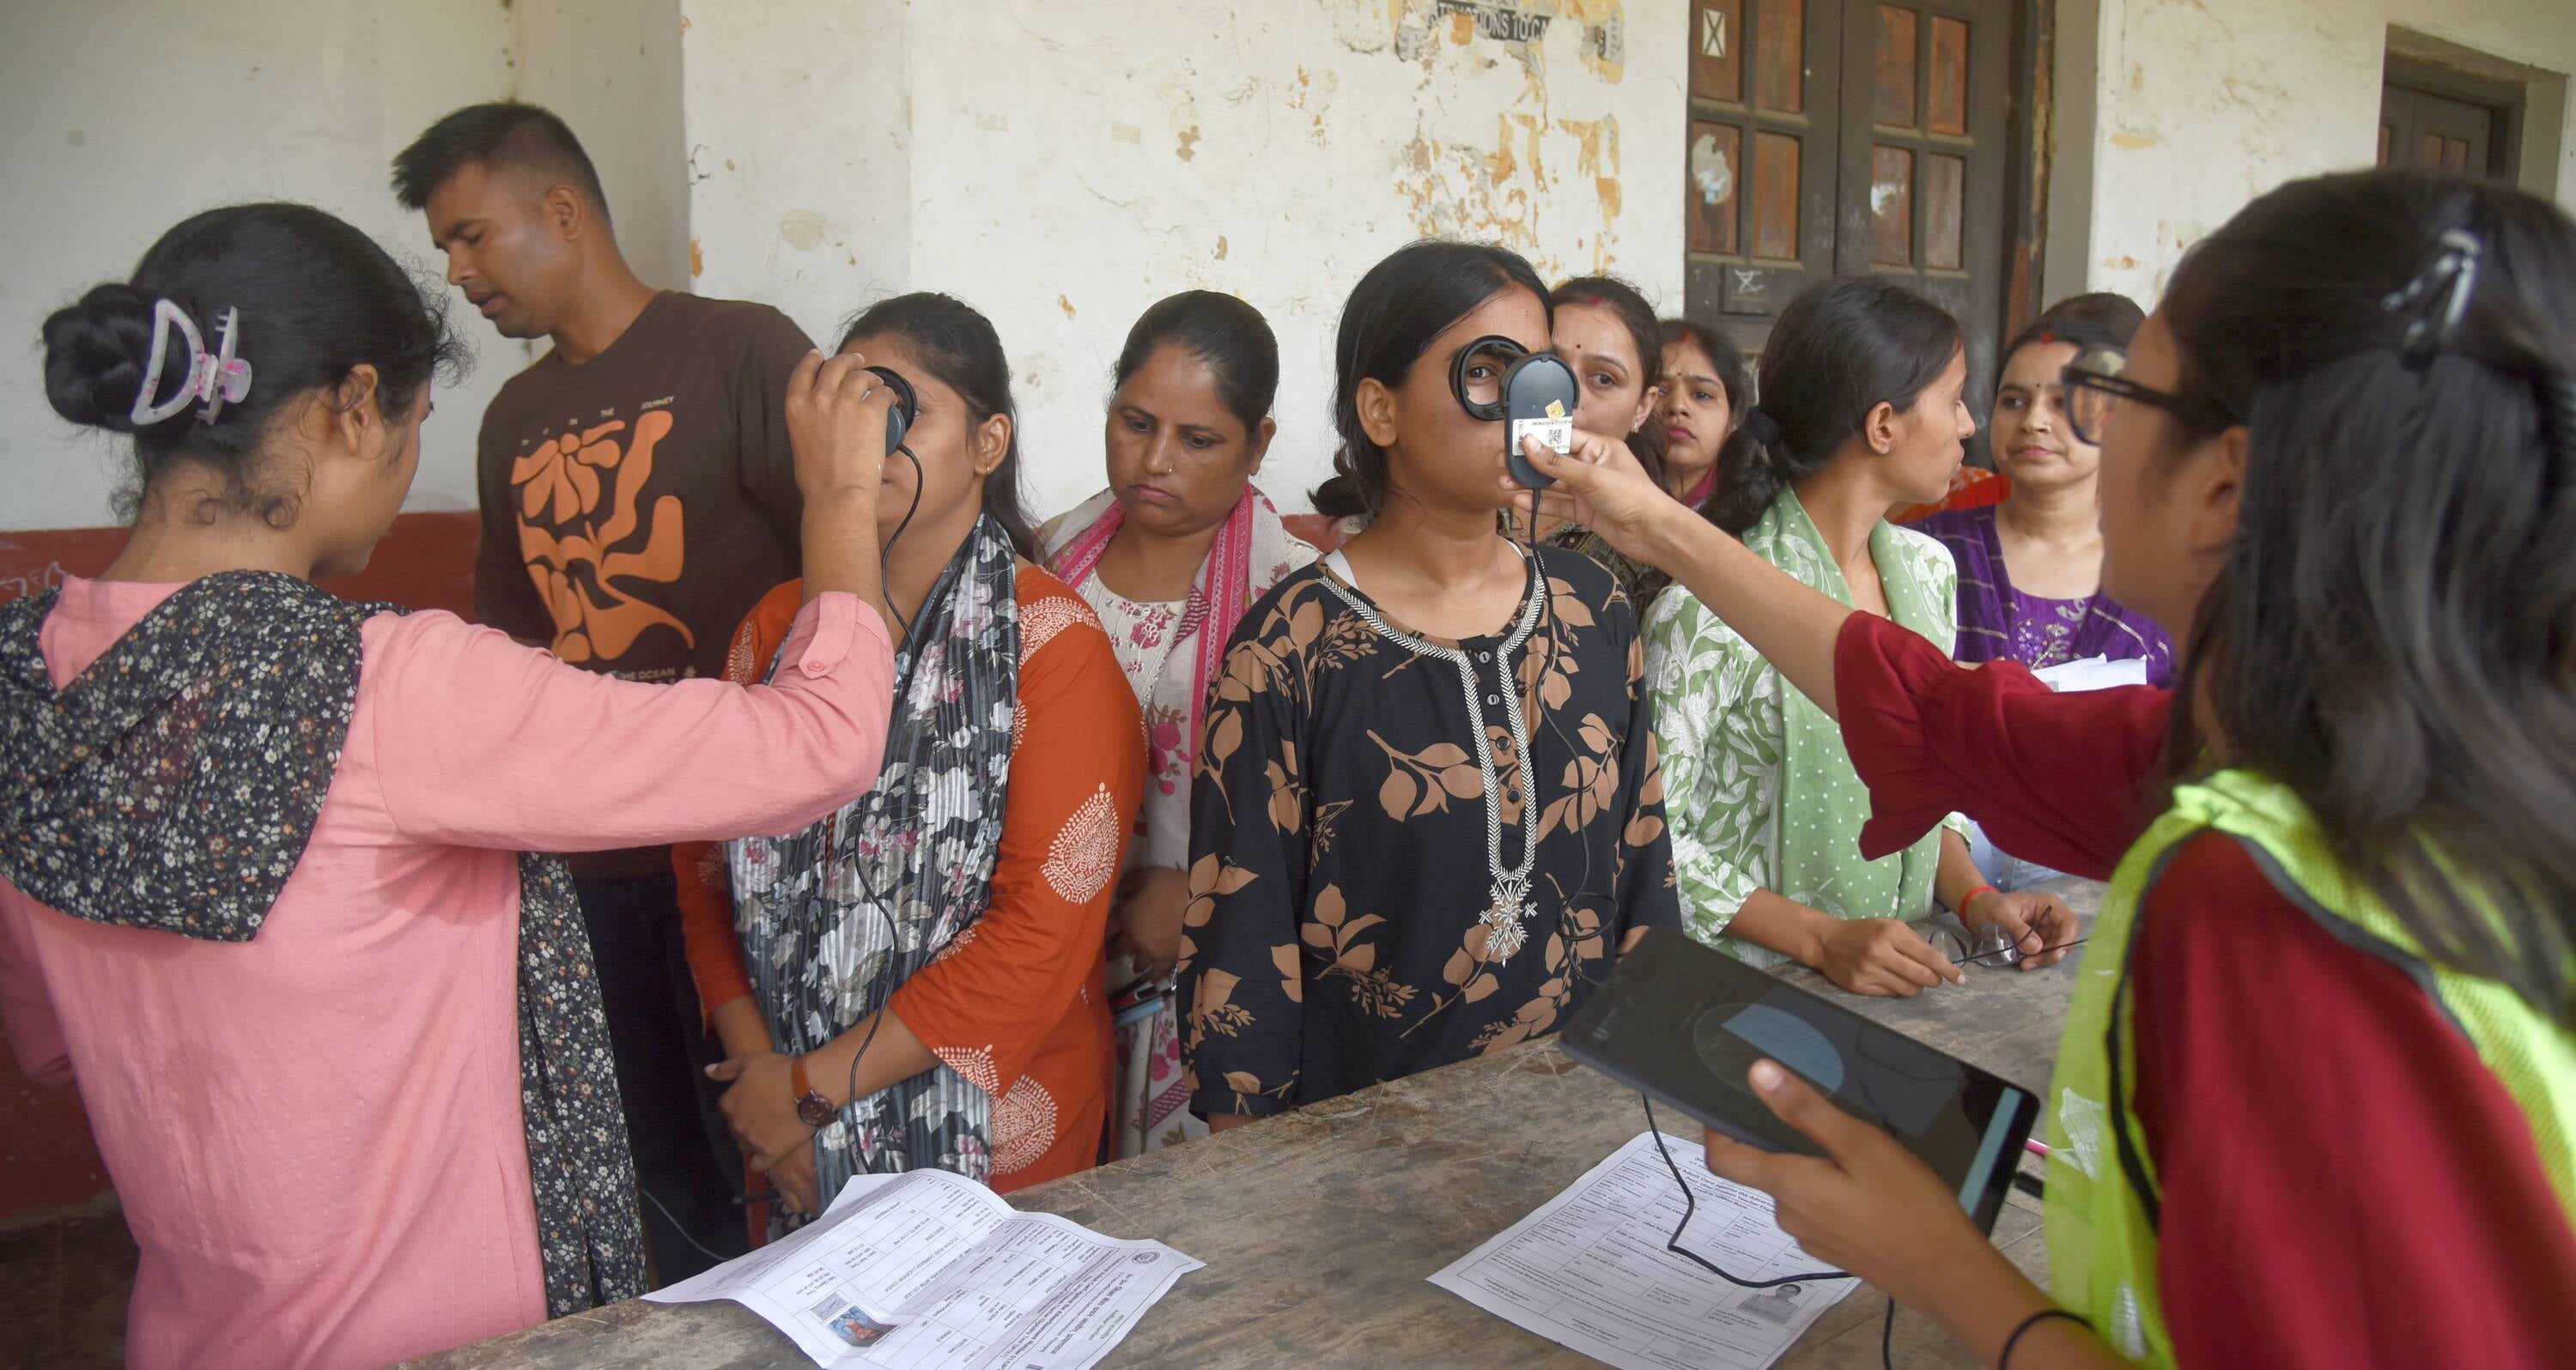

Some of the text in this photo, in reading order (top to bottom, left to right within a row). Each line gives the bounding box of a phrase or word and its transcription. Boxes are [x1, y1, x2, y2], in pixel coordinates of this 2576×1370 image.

[600, 408, 615, 418] THE
[641, 395, 675, 410] JOURNEY
[637, 668, 676, 680] OCEAN
